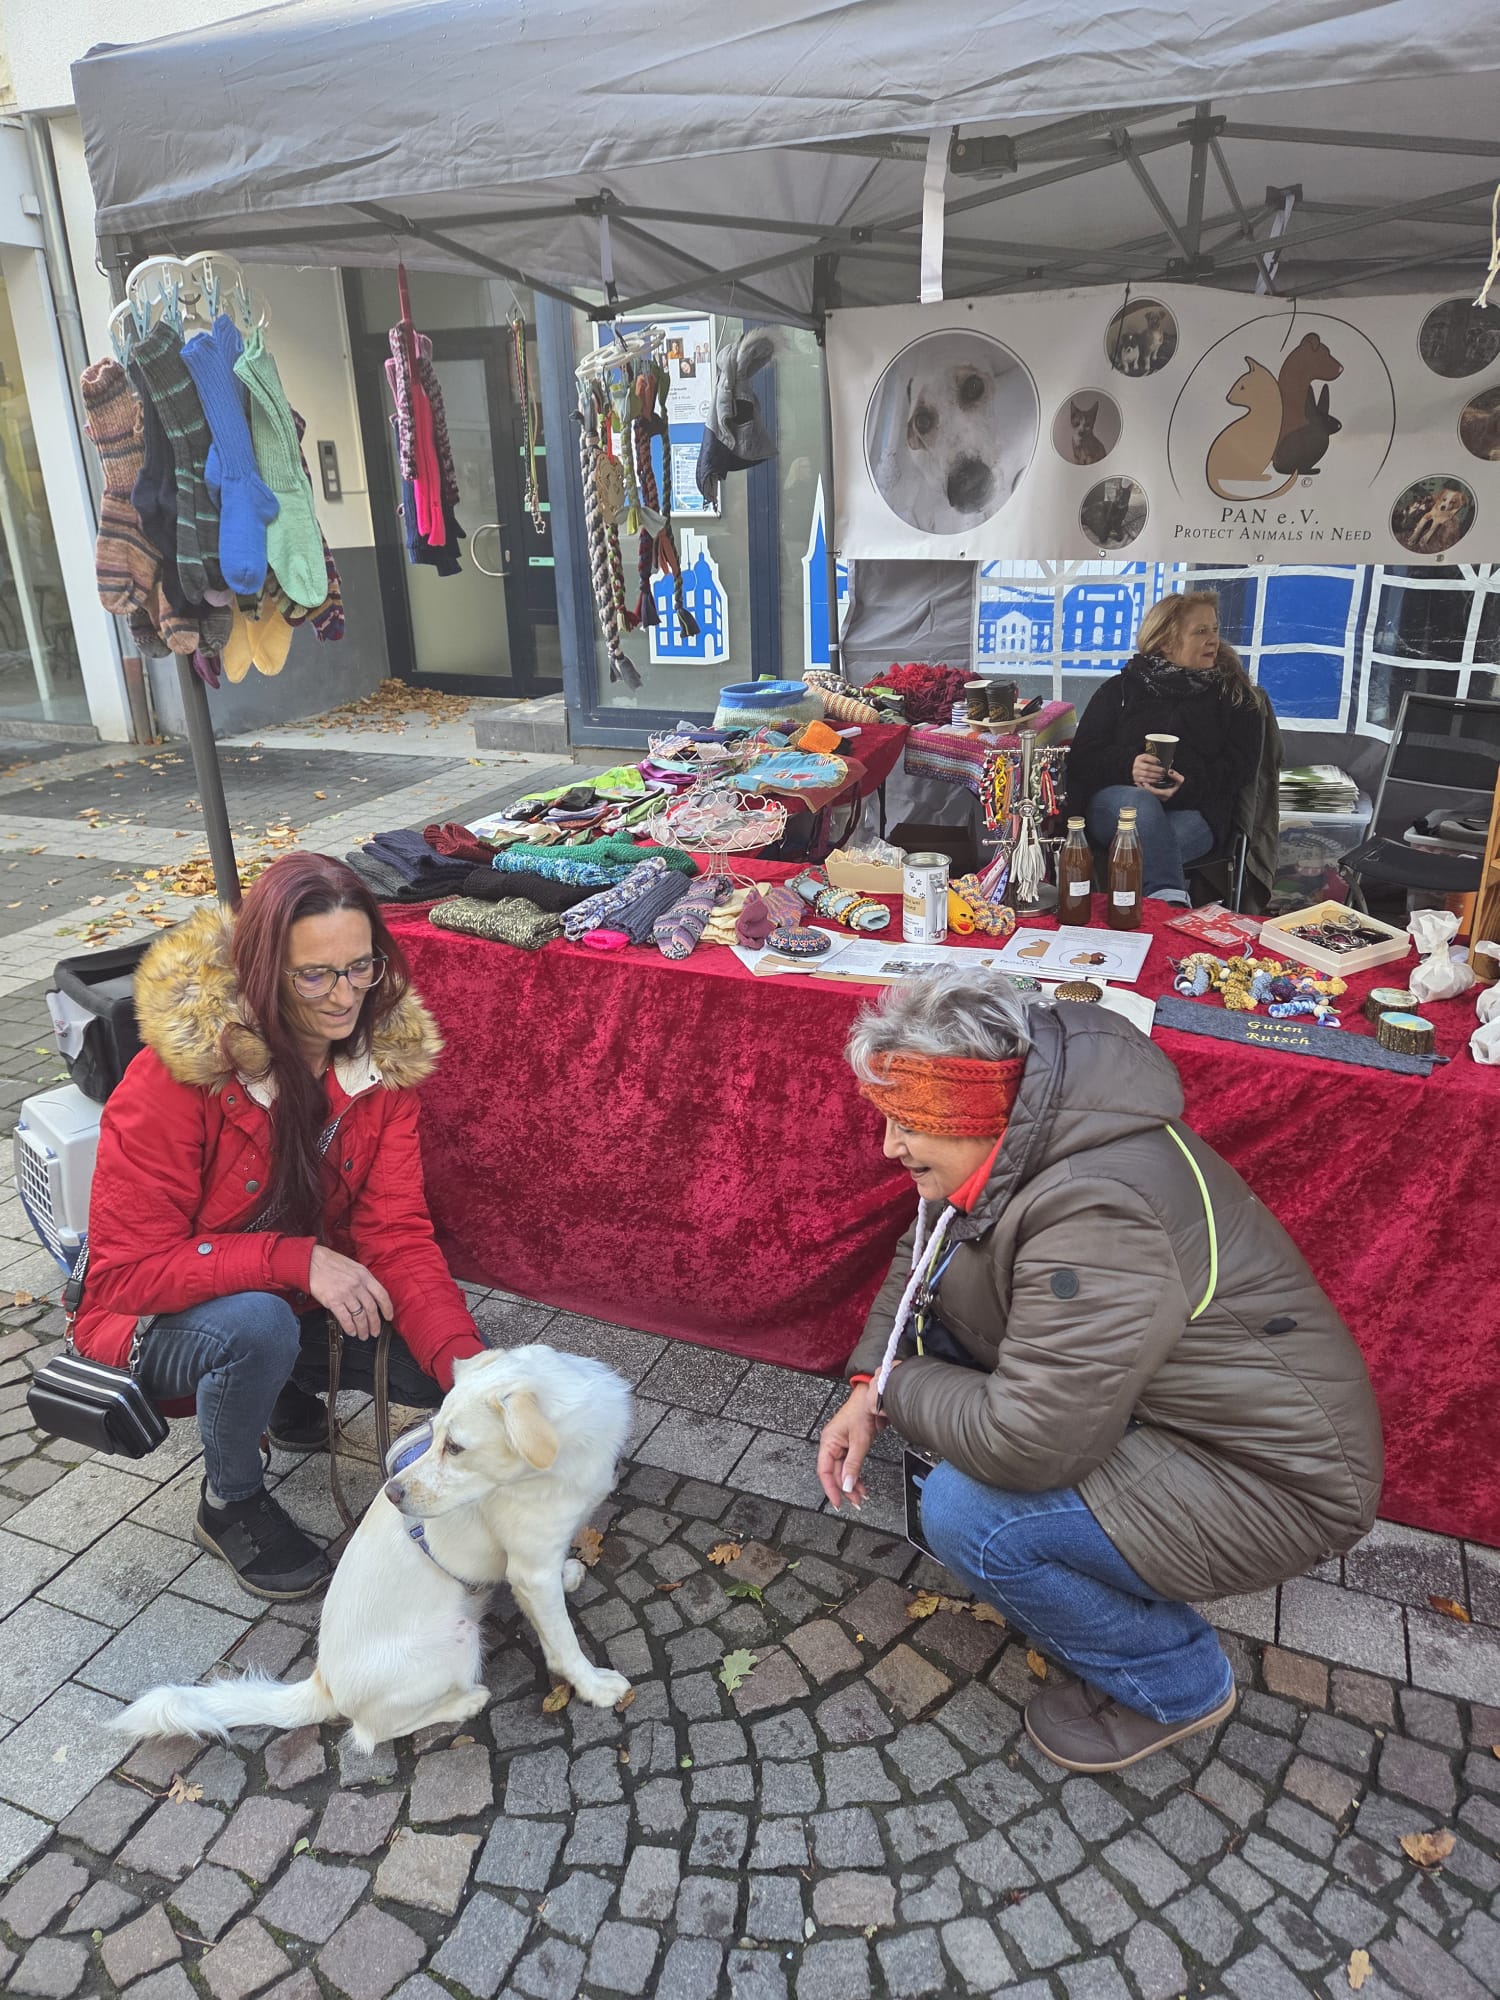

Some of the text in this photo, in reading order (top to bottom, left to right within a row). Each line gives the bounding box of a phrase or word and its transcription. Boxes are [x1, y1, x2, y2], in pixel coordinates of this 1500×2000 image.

[1220, 507, 1320, 525] PAN e.V.
[1173, 524, 1235, 539] PROTECT
[1239, 526, 1304, 541] ANIMALS
[1331, 527, 1373, 542] NEED
[1247, 1021, 1303, 1034] Guten
[1246, 1032, 1313, 1046] Rutsch
